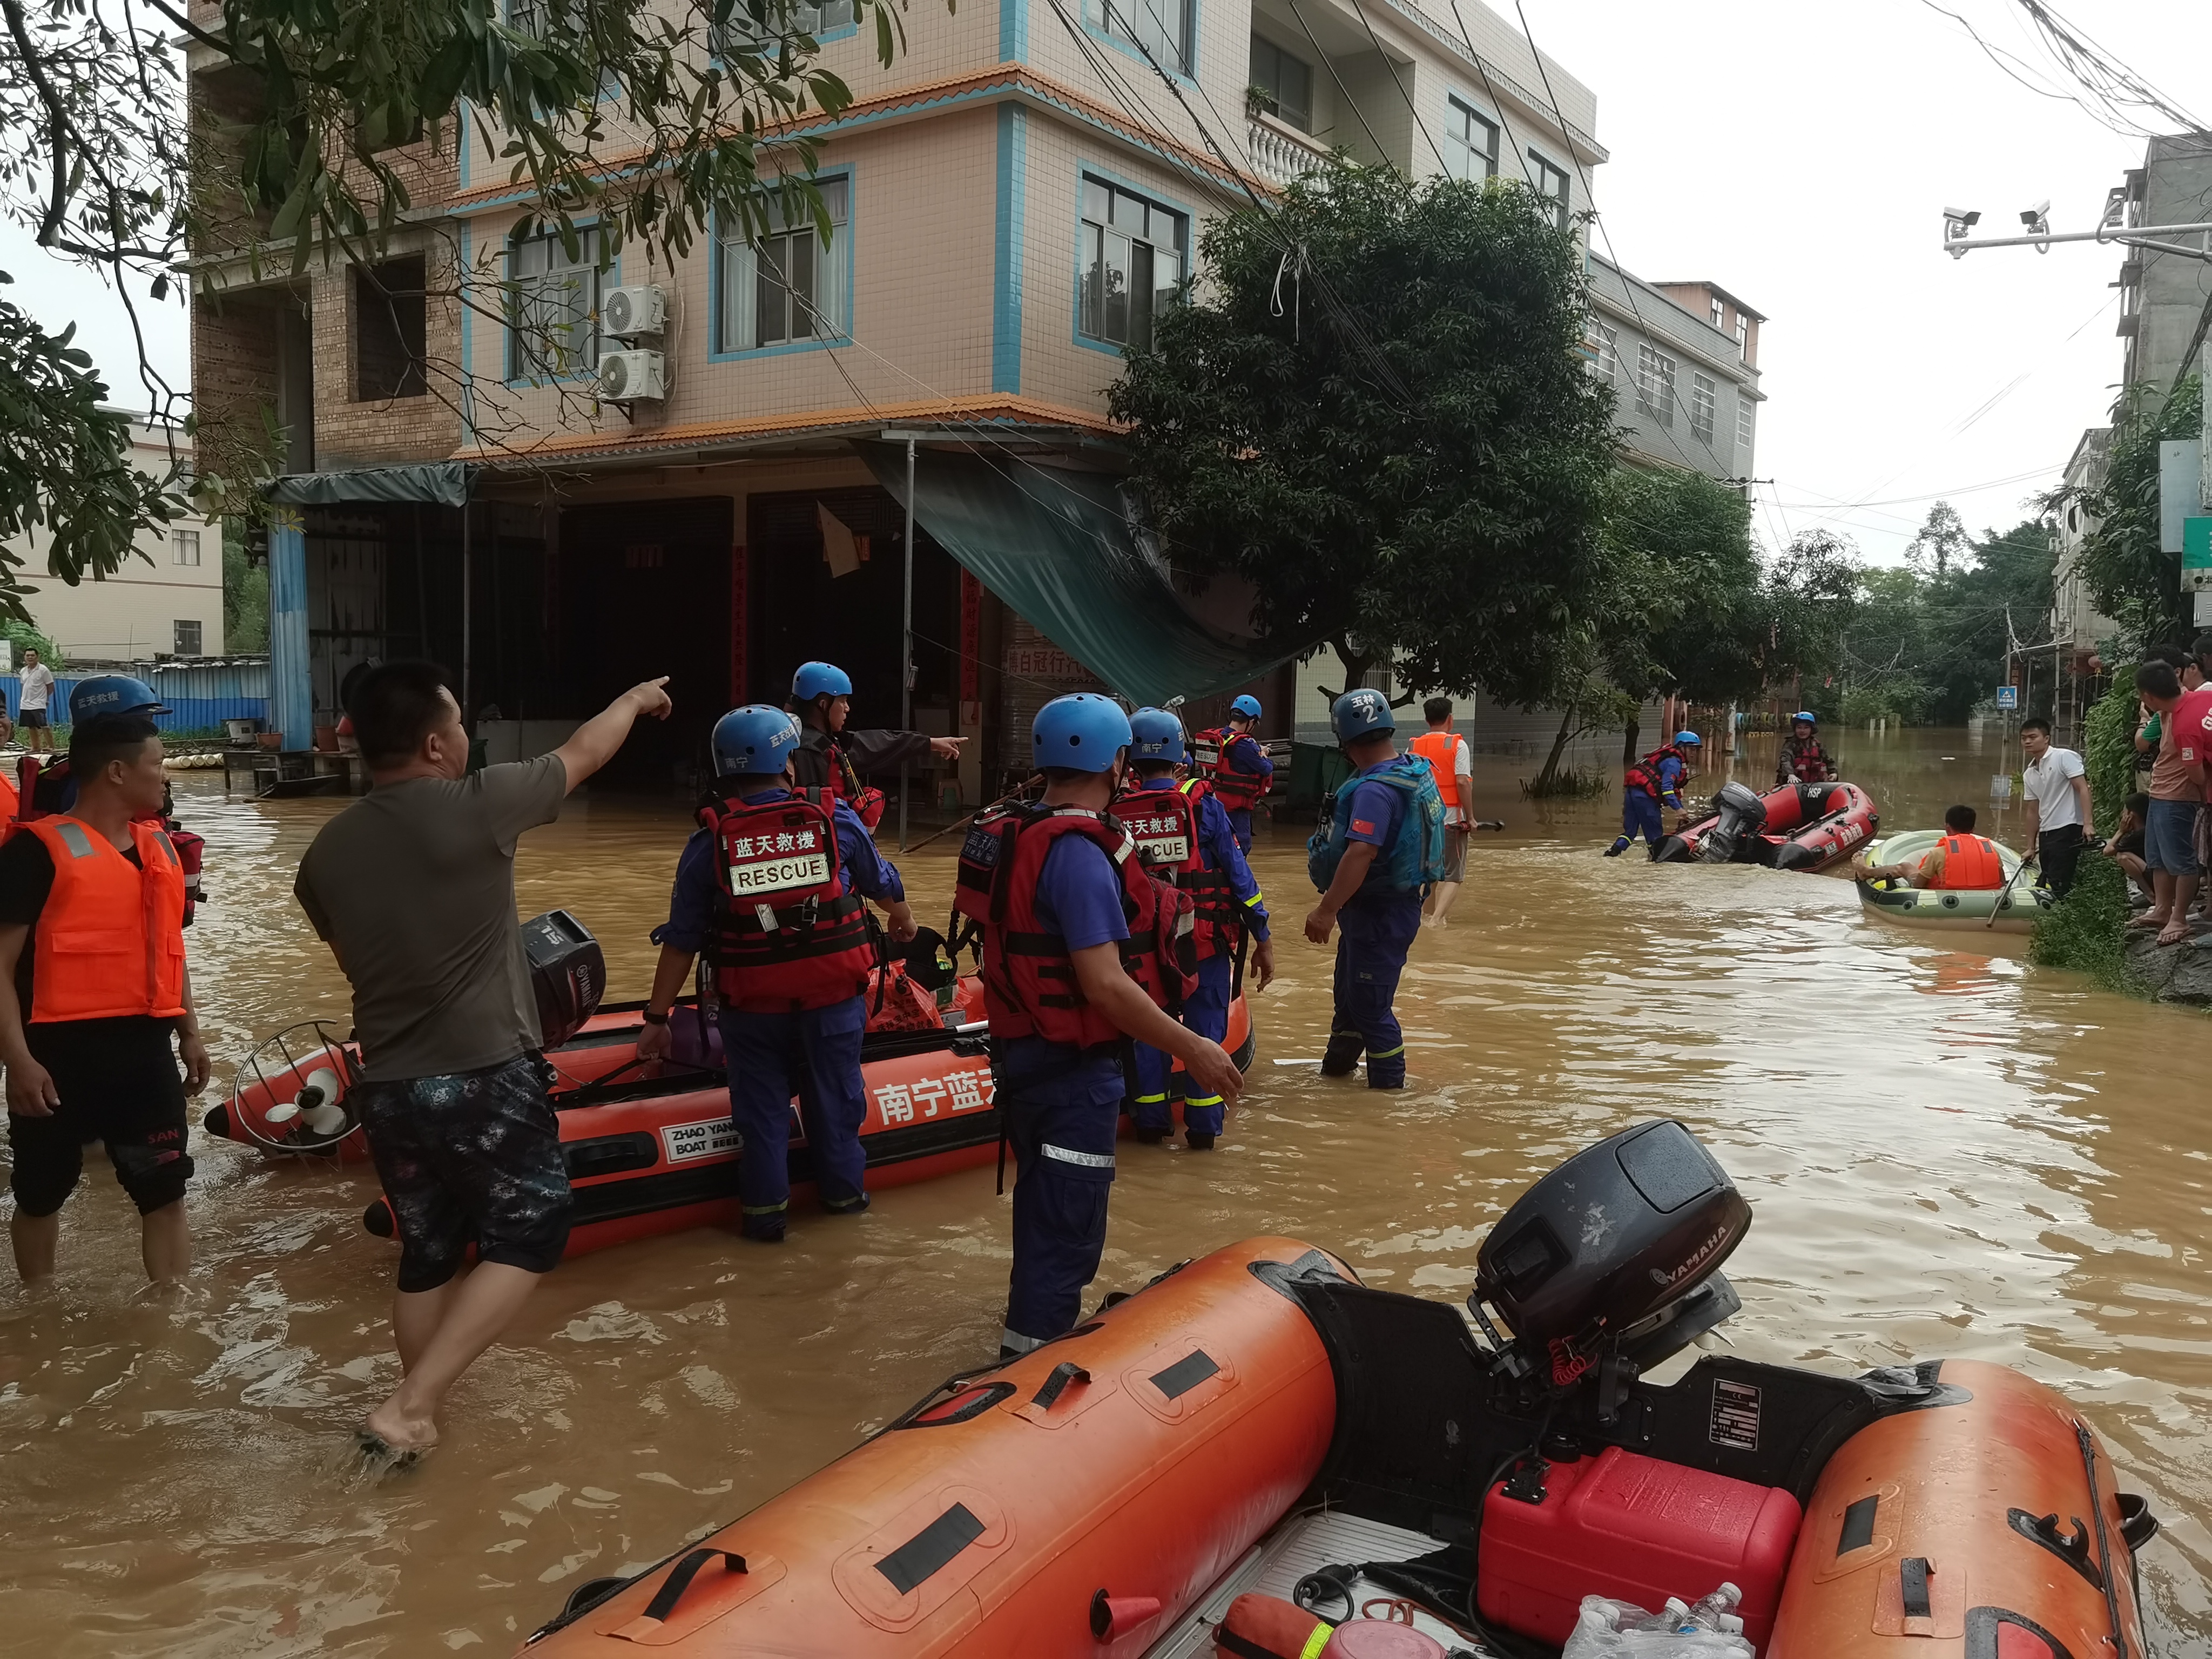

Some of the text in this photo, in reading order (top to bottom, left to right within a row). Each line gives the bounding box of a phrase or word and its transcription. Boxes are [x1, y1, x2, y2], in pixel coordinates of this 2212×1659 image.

[1351, 693, 1375, 709] 玉林
[1362, 705, 1378, 724] 2
[1142, 743, 1162, 753] 南宁
[725, 757, 748, 769] 南宁
[1808, 787, 1822, 798] HSP
[734, 830, 815, 858] 蓝天救援
[1142, 842, 1183, 857] CUE
[738, 860, 822, 888] RESCUE
[672, 1122, 733, 1141] ZHAO YAN
[676, 1140, 707, 1155] BOAT
[1667, 1226, 1727, 1282] YAMAHA
